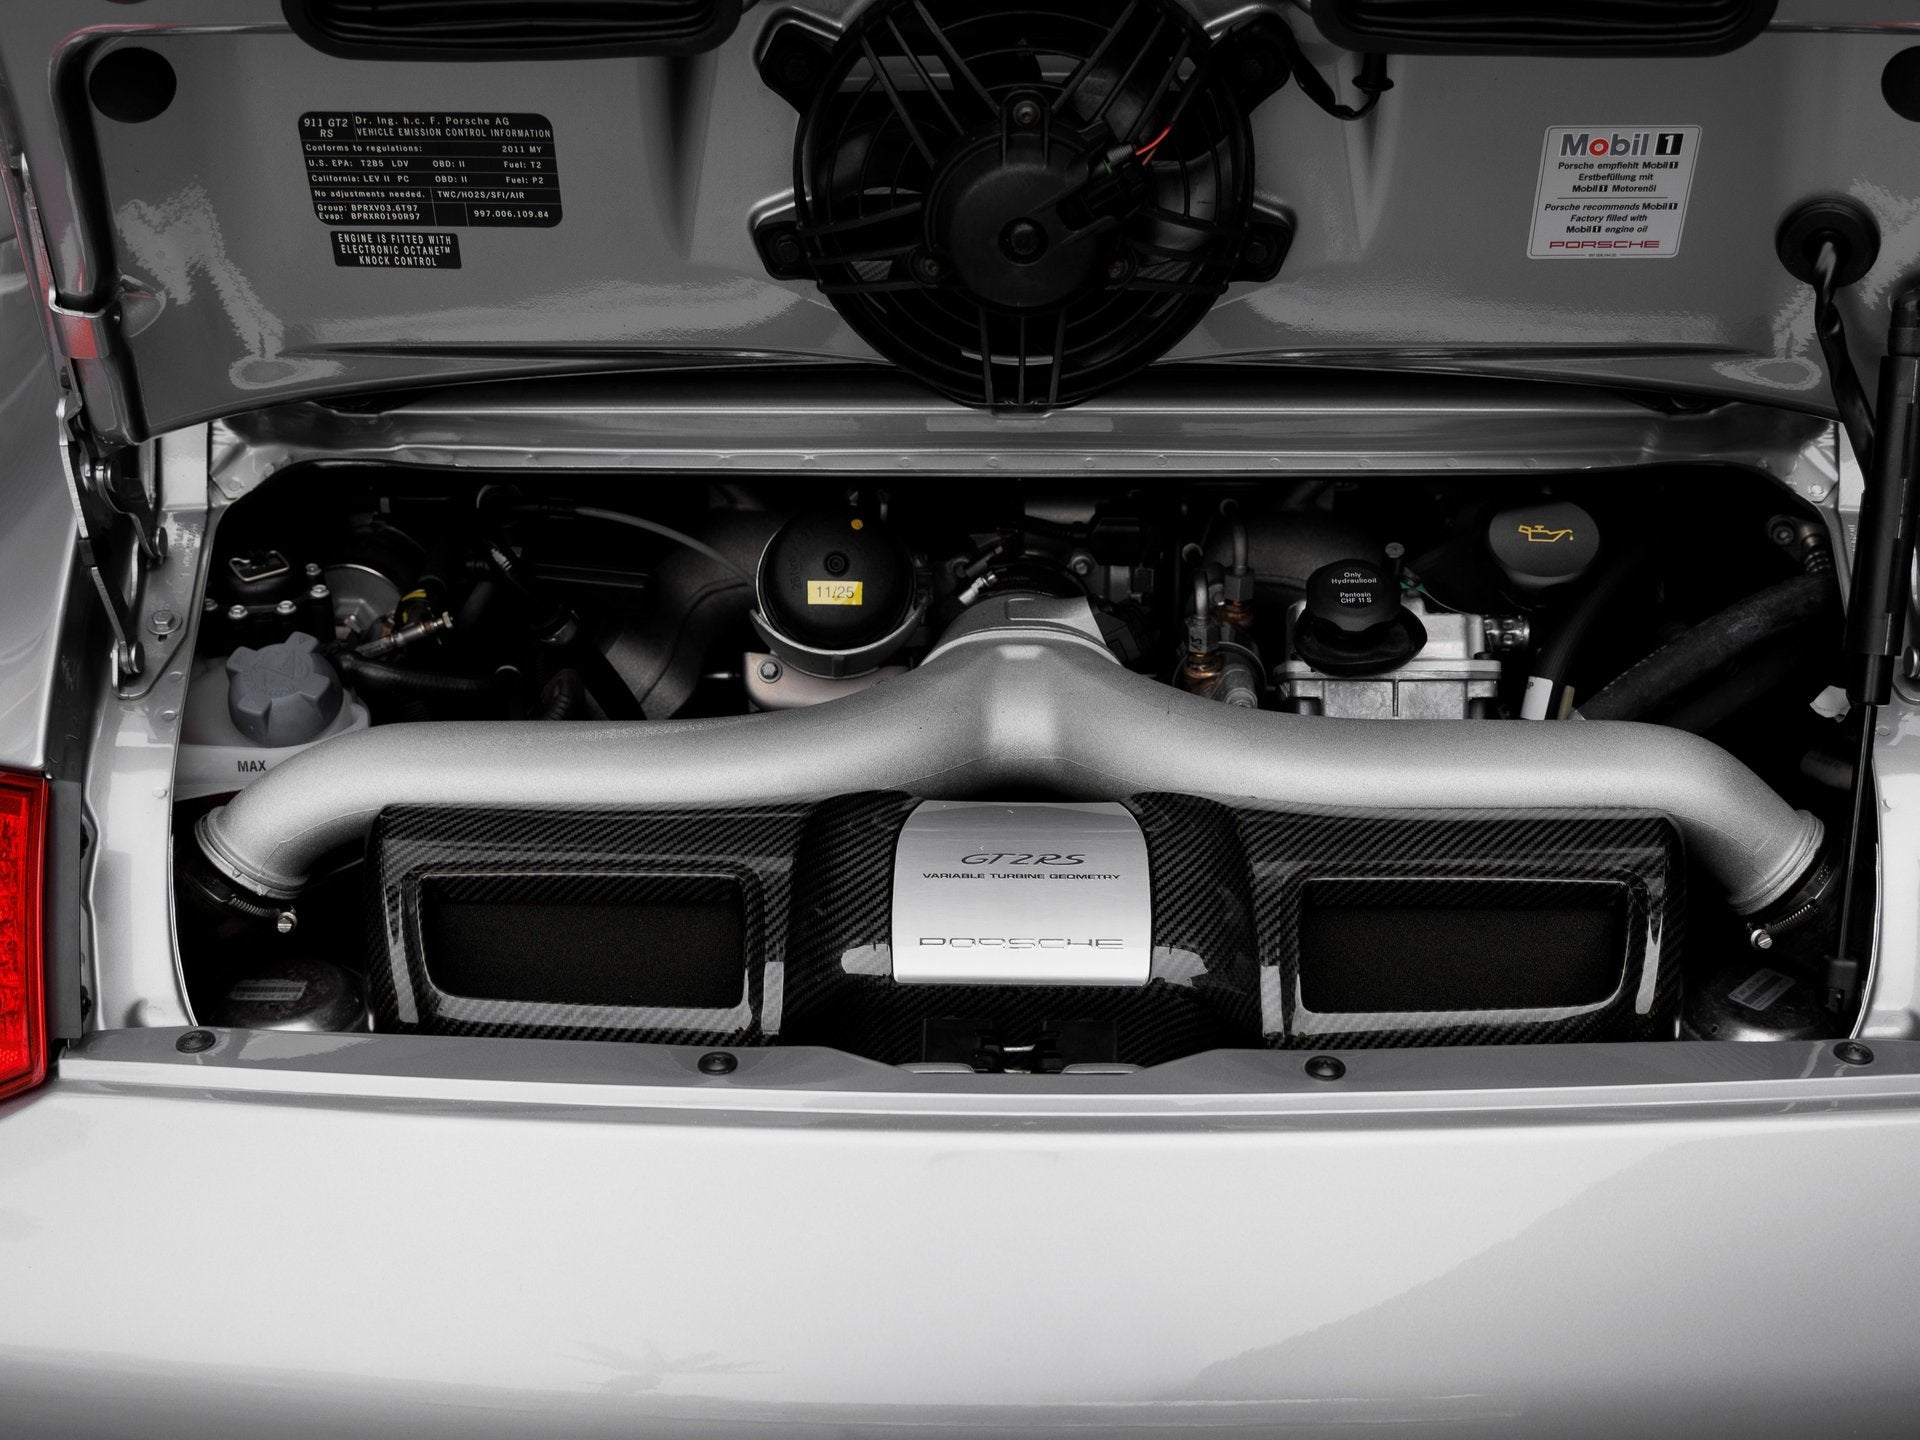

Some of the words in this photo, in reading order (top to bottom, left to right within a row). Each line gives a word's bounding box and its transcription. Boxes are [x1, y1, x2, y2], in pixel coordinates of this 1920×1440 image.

[304, 118, 323, 127] 911
[328, 118, 348, 128] GT2
[355, 116, 372, 125] Dr.
[377, 116, 399, 126] Ing.
[403, 116, 425, 125] h.c.
[430, 116, 441, 125] F.
[446, 116, 490, 126] Porsche
[495, 117, 510, 126] AG
[320, 129, 334, 138] RS
[357, 128, 394, 136] VEHICLE
[399, 128, 442, 137] EMISSION
[446, 128, 487, 137] CONTROL
[491, 129, 551, 138] INFORMATION
[305, 144, 349, 152] Conforms
[366, 144, 422, 153] regulations:
[502, 145, 525, 153] 2011
[529, 145, 542, 153] MY
[1560, 133, 1650, 157] Mobil
[432, 160, 455, 168] OBD:
[530, 161, 542, 169] T2
[1558, 161, 1594, 170] Porsche
[1597, 161, 1639, 171] empfiehlt
[435, 175, 457, 183] OBD:
[506, 176, 529, 184] Fuel:
[1578, 173, 1636, 182] Erstbefüllung
[1639, 173, 1654, 181] mit
[1612, 184, 1657, 192] Motorenöl
[330, 190, 385, 199] adjustments
[389, 190, 425, 198] needed.
[317, 204, 348, 212] Group:
[1544, 203, 1580, 211] Porsche
[1582, 203, 1640, 211] recommends
[474, 210, 549, 218] 997.006.109.84
[1570, 214, 1604, 223] Factory
[1606, 214, 1627, 222] filled
[1630, 214, 1648, 222] with
[1637, 225, 1648, 233] oil
[338, 233, 373, 243] ENGINE
[377, 234, 387, 243] IS
[391, 234, 424, 244] FITTED
[428, 235, 451, 245] WITH
[341, 244, 400, 254] ELECTRONIC
[1549, 240, 1660, 249] PORSCHE
[359, 256, 390, 265] KNOCK
[394, 256, 437, 266] CONTROL
[1331, 577, 1377, 585] Hydraulicoil
[816, 585, 855, 599] 11/25
[237, 760, 267, 773] MAX
[922, 872, 986, 880] VARIABLE
[919, 937, 1124, 950] PORSCHE
